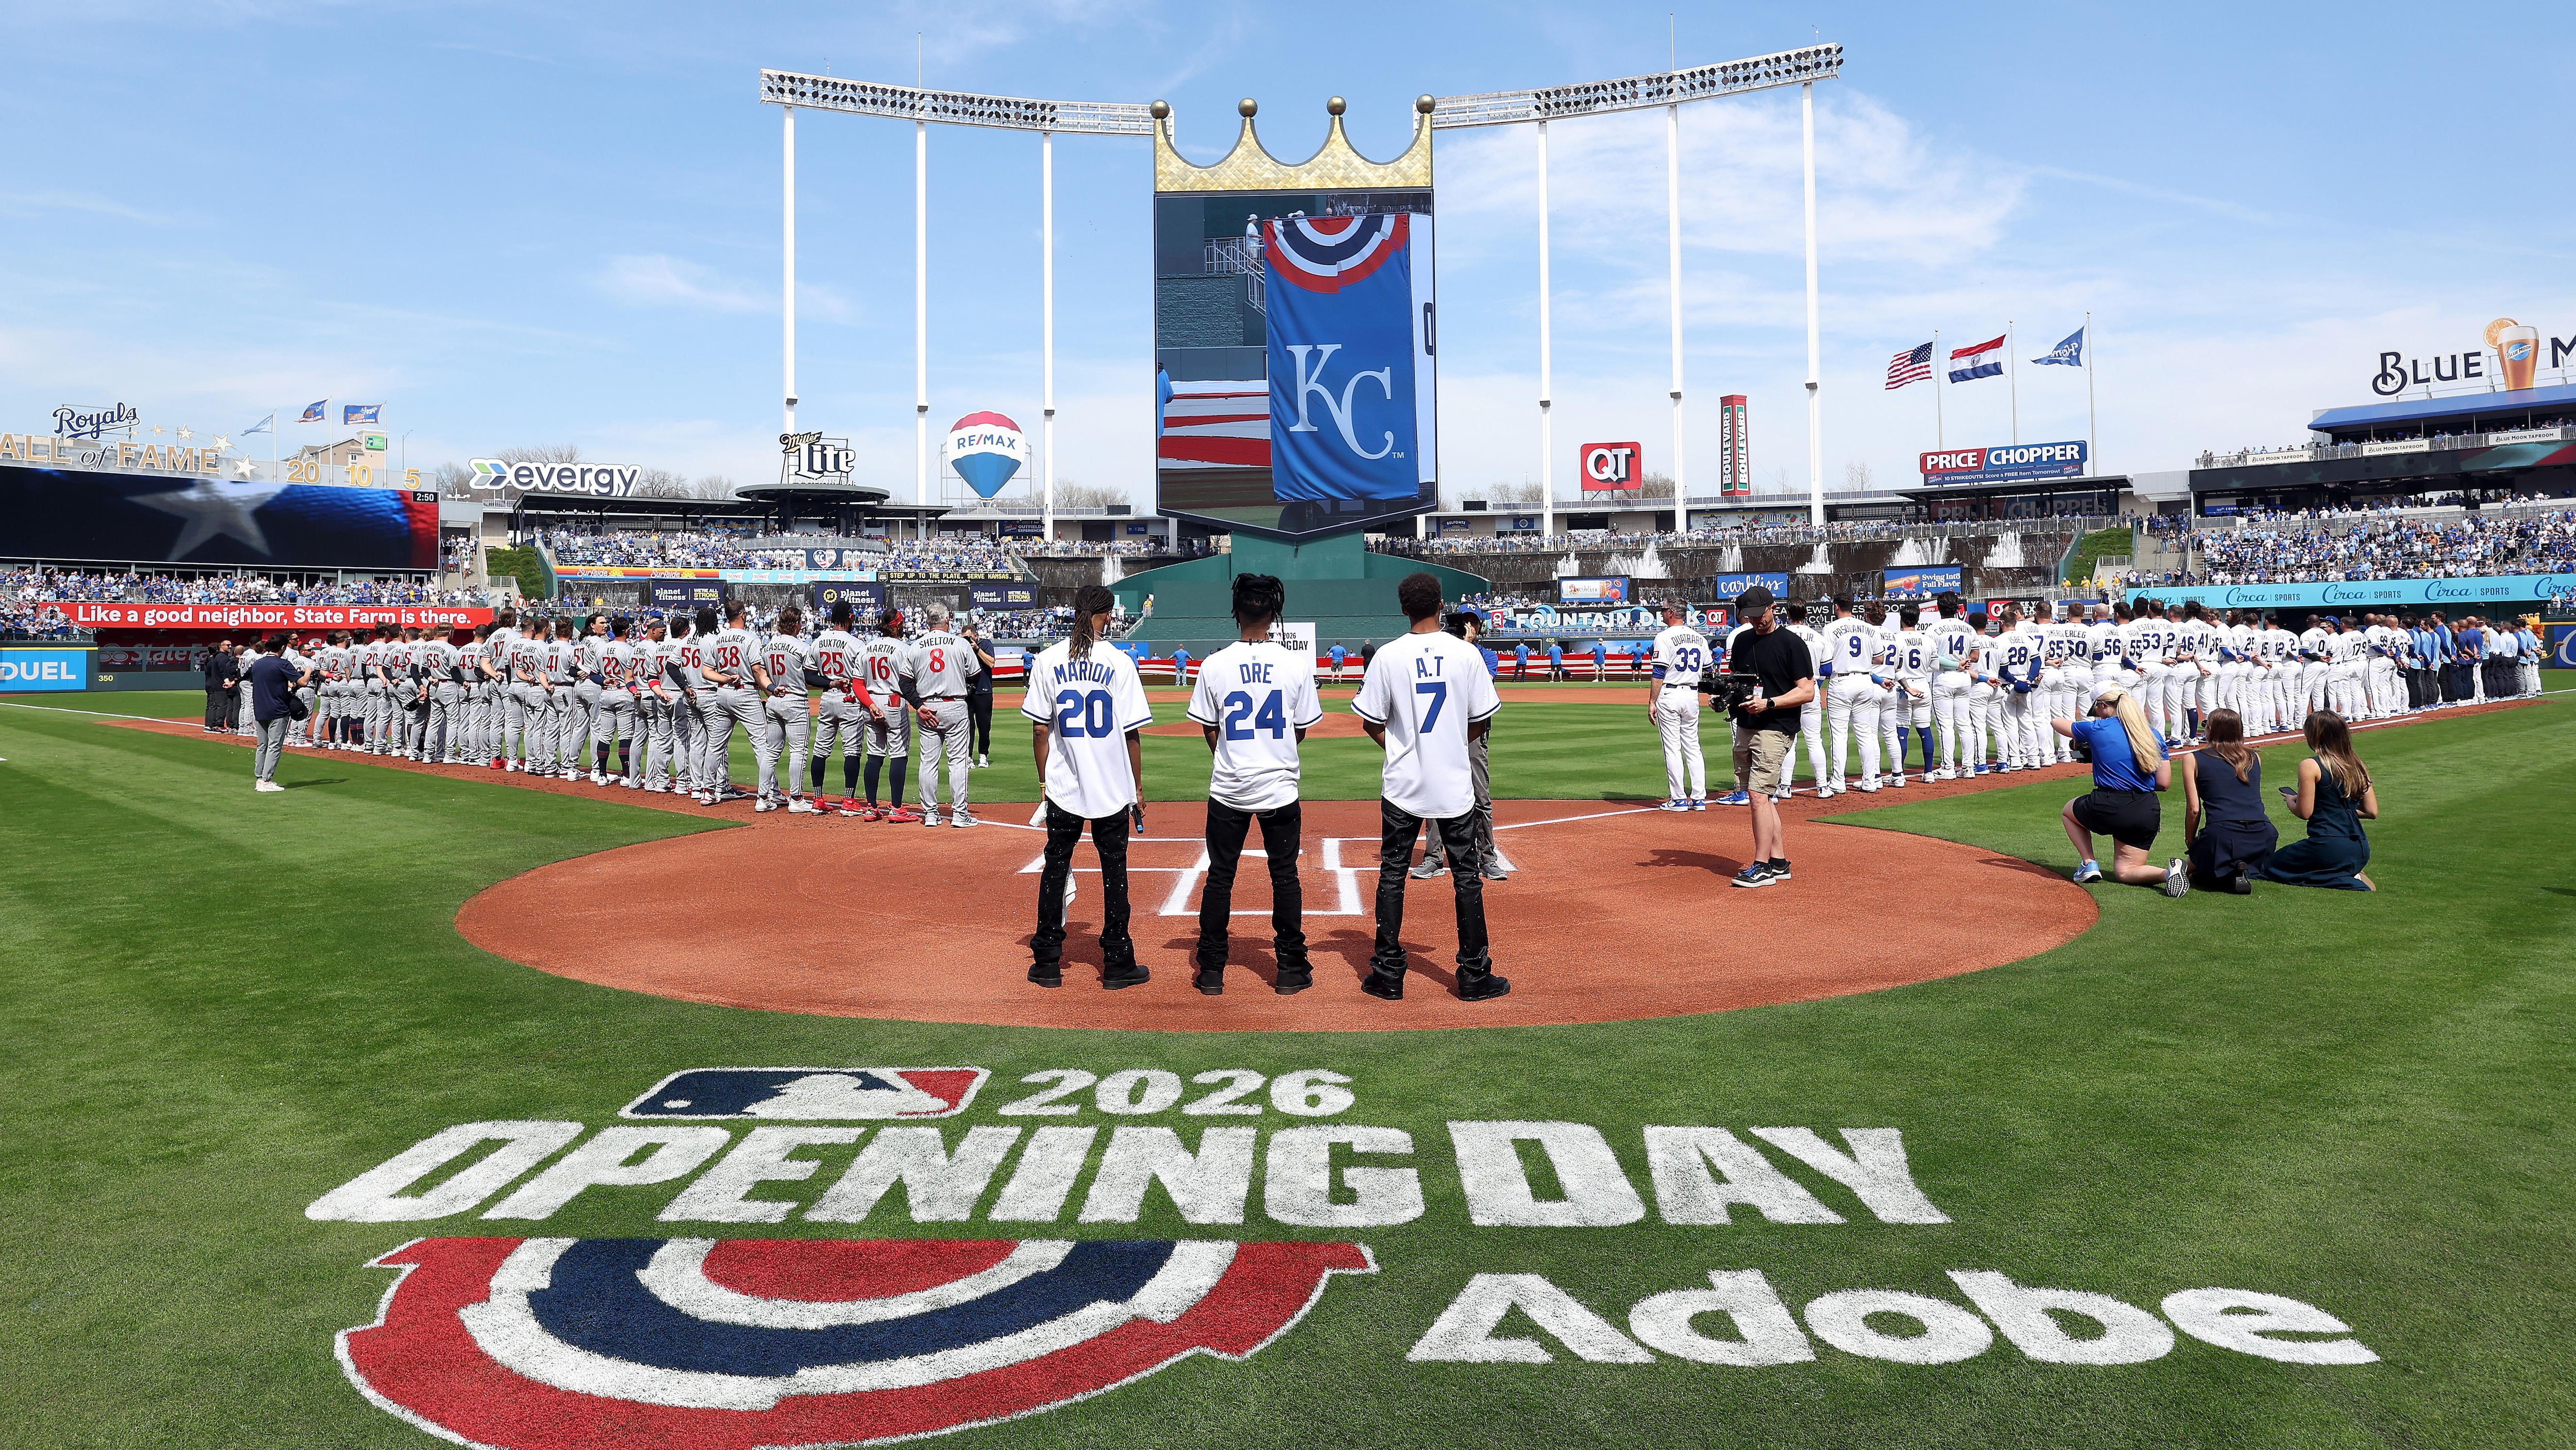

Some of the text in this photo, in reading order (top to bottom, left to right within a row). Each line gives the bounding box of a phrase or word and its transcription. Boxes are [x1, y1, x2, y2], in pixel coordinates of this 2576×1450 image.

[2506, 350, 2519, 360] BLUE
[2372, 351, 2483, 396] BLUE
[1286, 344, 1393, 460] KC
[53, 402, 140, 439] Royals
[781, 433, 822, 452] Miller
[957, 434, 1016, 450] RE/MAX
[1723, 412, 1732, 484] BOULEVARD
[1737, 411, 1748, 484] BOULEVARD
[80, 442, 221, 474] of FAME
[795, 443, 856, 479] Lite
[1587, 448, 1632, 482] QT
[1927, 444, 2080, 470] PRICE CHOPPER
[287, 460, 420, 489] 20 10 5
[514, 466, 639, 497] evergy
[417, 493, 434, 502] 2:50
[577, 568, 608, 577] Surfside
[650, 569, 681, 578] Surfside
[655, 587, 681, 596] planet
[840, 589, 870, 598] planet
[2226, 587, 2267, 606] Circa
[2322, 584, 2401, 604] Circa SPORTS
[2425, 581, 2509, 601] Circa SPORTS
[78, 606, 471, 626] Like a good neighbor, State Farm is there.
[1516, 612, 1632, 628] FOUNTAIN
[1708, 611, 1724, 623] QT
[1833, 625, 1875, 639] PASQUANTINO
[1935, 624, 1973, 636] CAGLIANONE
[2065, 630, 2086, 638] ERCEG
[494, 641, 504, 657] 17
[819, 639, 847, 650] BUXTON
[867, 644, 896, 655] MARTIN
[919, 638, 955, 649] SHELTON
[1850, 636, 1861, 657] 9
[1905, 638, 1922, 646] INDIA
[1948, 635, 1964, 655] 14
[2049, 640, 2064, 658] 65
[2104, 639, 2121, 655] 56
[2142, 633, 2161, 649] 53
[2198, 633, 2208, 649] 41
[2275, 642, 2284, 655] 12
[2380, 635, 2387, 647] 99
[427, 653, 440, 669] 65
[574, 647, 585, 665] 57
[634, 647, 647, 656] LEWIS
[682, 647, 701, 668] 56
[718, 645, 740, 668] 38
[929, 648, 945, 673] 8
[1675, 648, 1700, 672] 33
[1909, 649, 1920, 669] 6
[2008, 646, 2027, 665] 28
[0, 662, 76, 680] DUEL
[331, 659, 338, 672] 2
[351, 655, 356, 668] 4
[459, 655, 475, 670] 43
[547, 655, 558, 672] 41
[603, 657, 621, 675] 22
[632, 658, 646, 676] 23
[769, 654, 786, 675] 15
[820, 652, 843, 674] 25
[869, 657, 890, 680] 16
[1416, 656, 1444, 678] A.T
[1053, 662, 1115, 687] MARION
[1239, 663, 1274, 685] DRE
[1056, 690, 1113, 738] 20
[1224, 690, 1286, 741] 24
[1416, 681, 1447, 733] 7
[999, 1066, 1356, 1117] 2026
[304, 1119, 1953, 1228] OPENING DAY
[1406, 1268, 2380, 1367] Adobe
